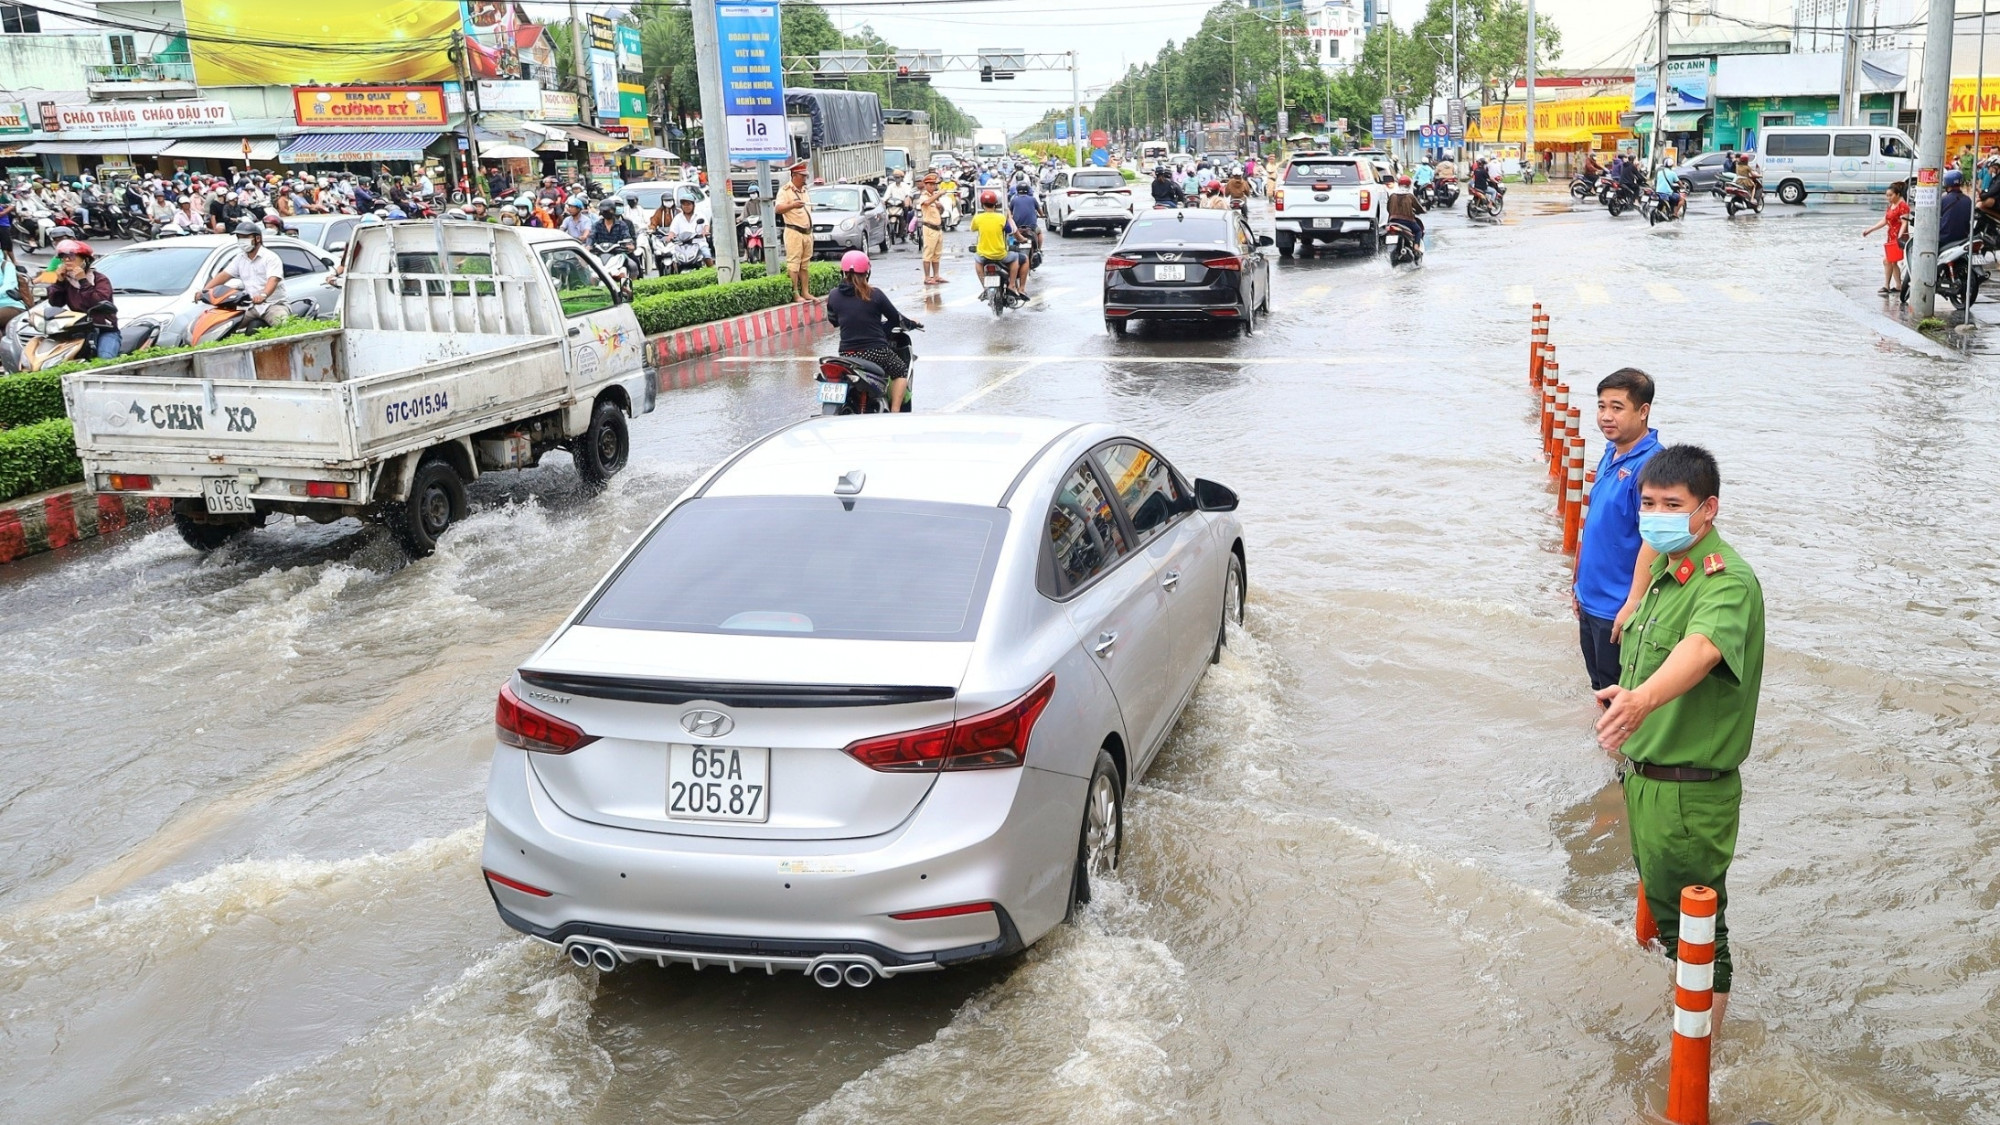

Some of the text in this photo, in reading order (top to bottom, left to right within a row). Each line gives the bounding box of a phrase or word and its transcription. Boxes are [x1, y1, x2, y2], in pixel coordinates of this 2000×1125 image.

[1667, 62, 1685, 73] GỌC
[1687, 60, 1706, 70] ANH
[366, 92, 391, 101] QUAY
[63, 109, 95, 125] CHÁO
[97, 106, 136, 123] TRẮNG
[142, 105, 174, 121] CHÁO
[177, 104, 201, 122] ĐẬU
[204, 106, 225, 119] 107
[331, 101, 384, 116] CƯỜNG
[746, 118, 767, 136] ila
[1557, 112, 1573, 128] KINH
[1588, 110, 1613, 126] KINH
[386, 391, 448, 424] 67C-015.94
[214, 479, 239, 495] 67C
[207, 496, 253, 512] 015.94
[529, 690, 572, 704] ACCENT
[692, 747, 742, 780] 65A
[671, 781, 763, 816] 205.87
